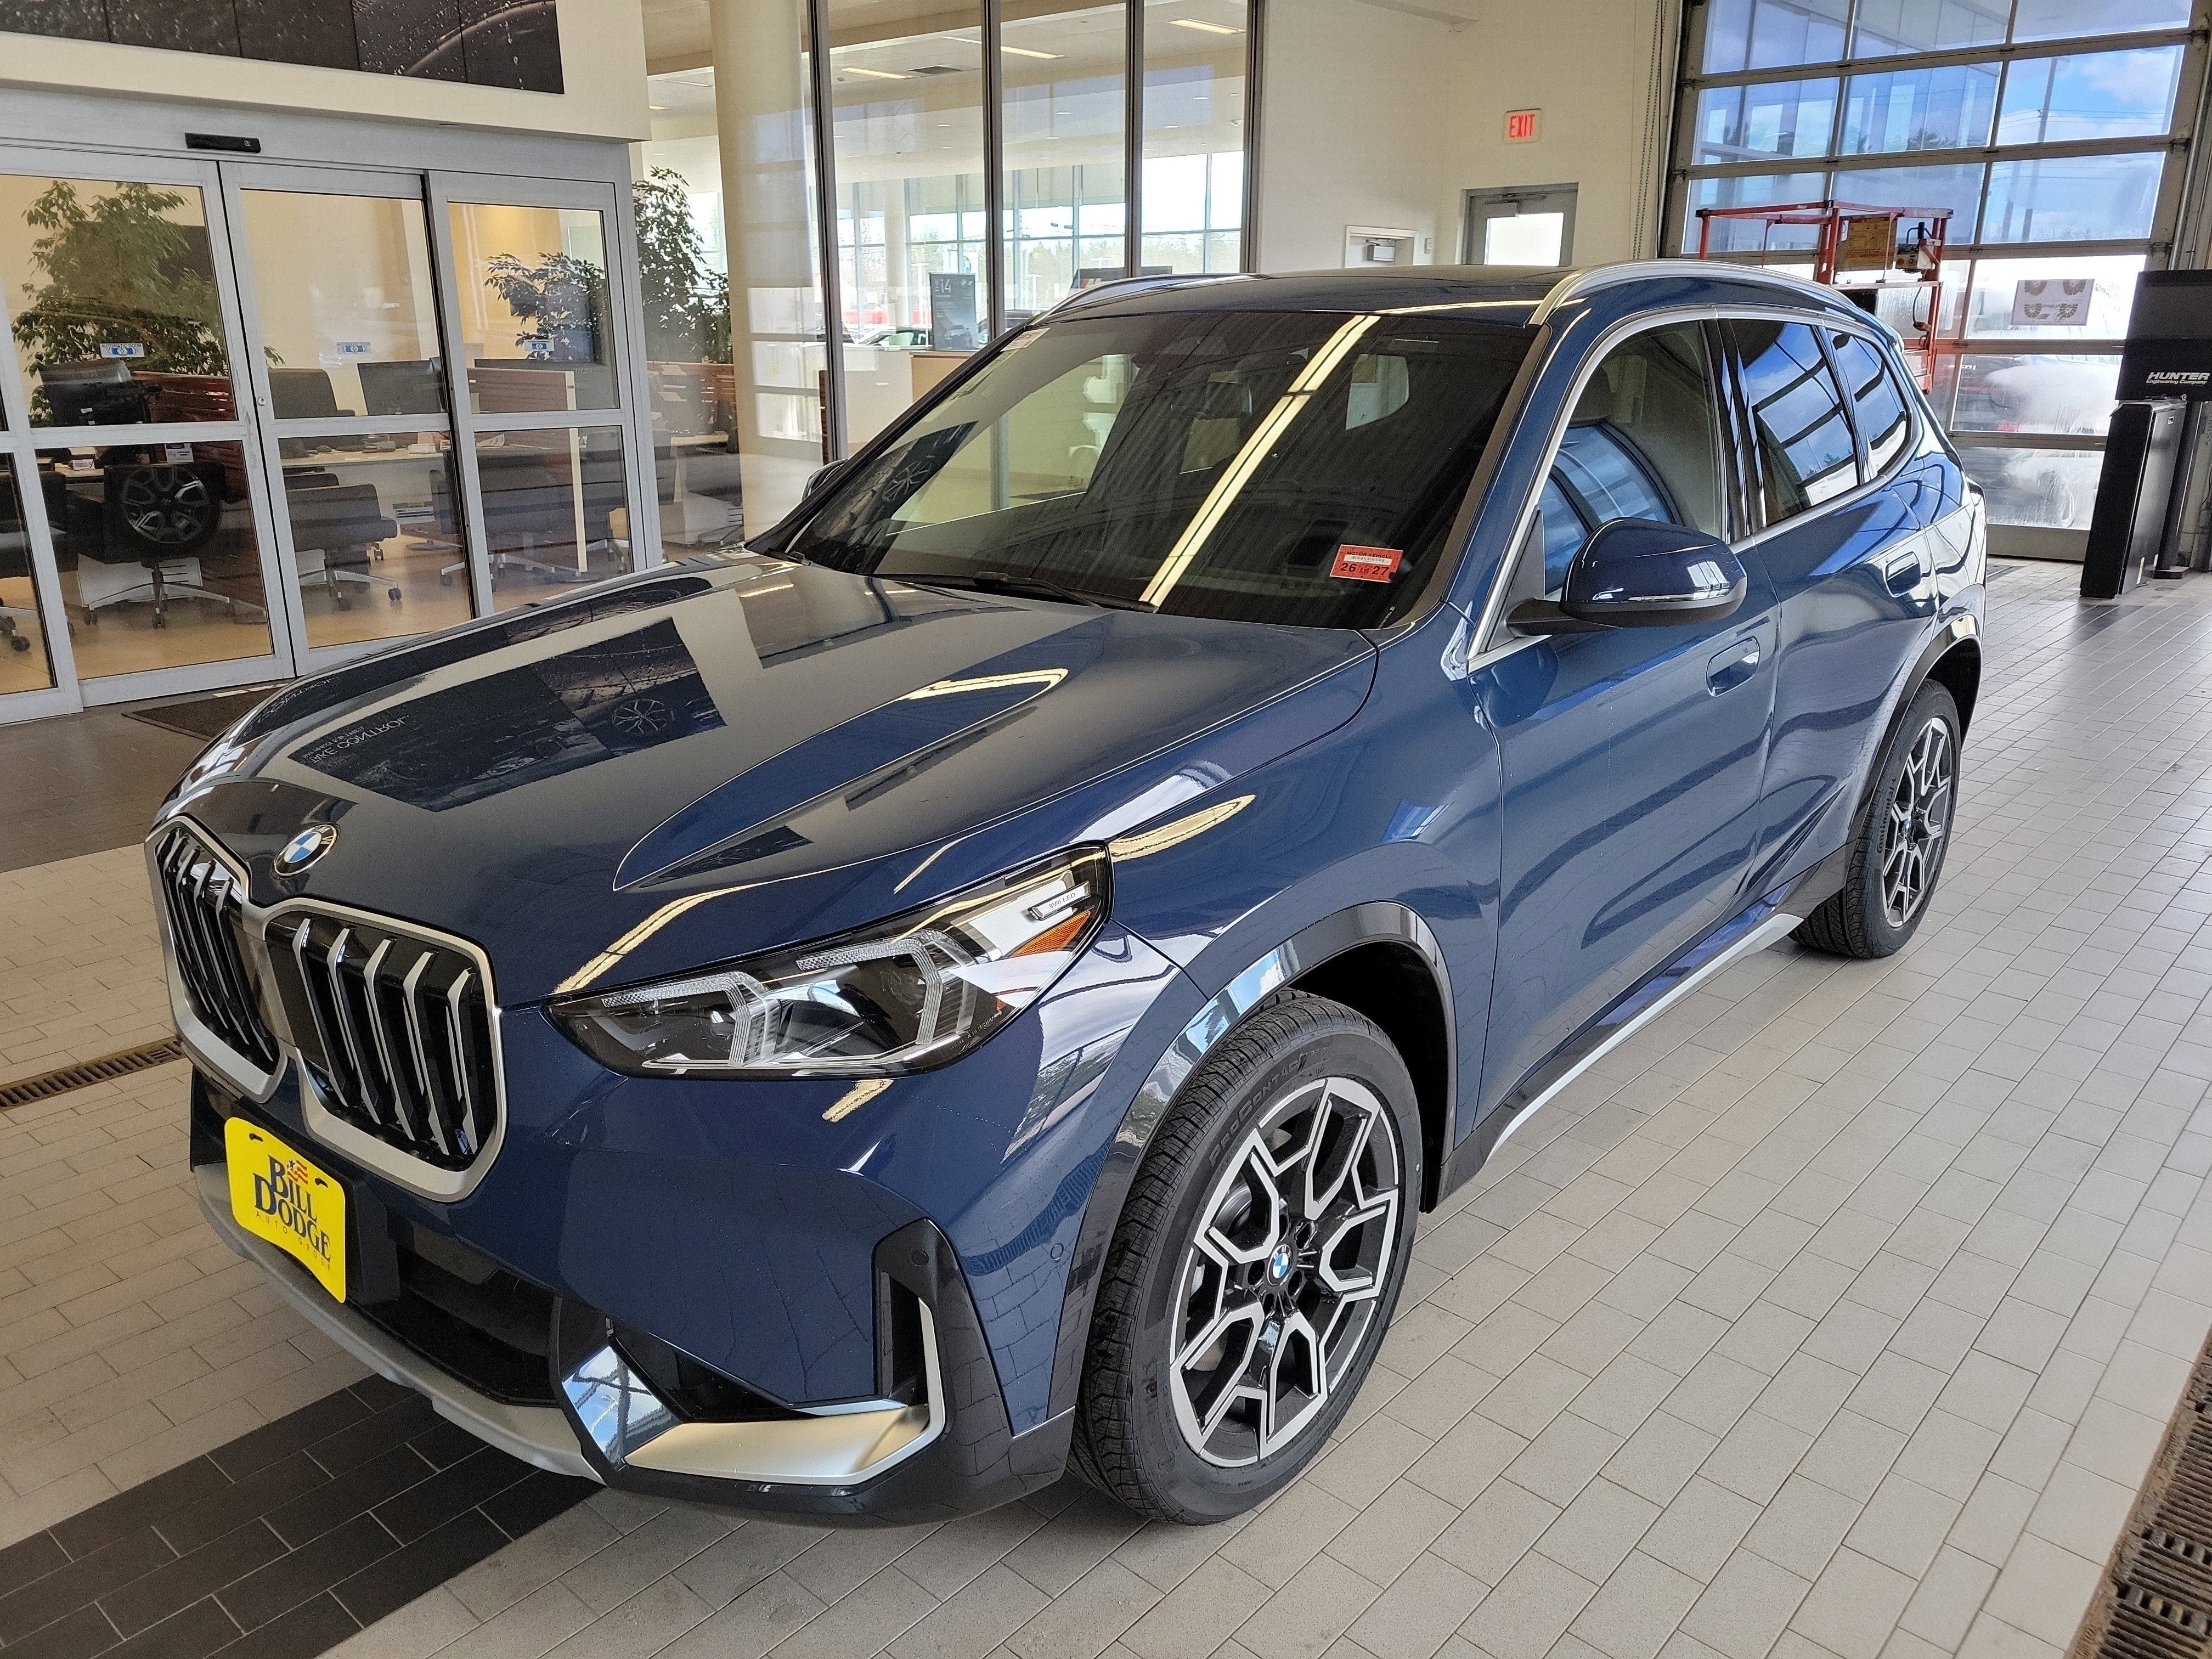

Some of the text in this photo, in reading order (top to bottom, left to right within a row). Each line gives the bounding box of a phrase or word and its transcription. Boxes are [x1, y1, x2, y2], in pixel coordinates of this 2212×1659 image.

[1509, 114, 1535, 138] EXIT
[2147, 371, 2211, 380] HUNTER
[1340, 562, 1357, 572] 26
[1372, 566, 1390, 575] 27
[1048, 893, 1076, 909] BMW LED
[267, 1154, 318, 1223] BILL
[252, 1172, 331, 1263] DODGE
[255, 1210, 331, 1271] AUTO GROUP
